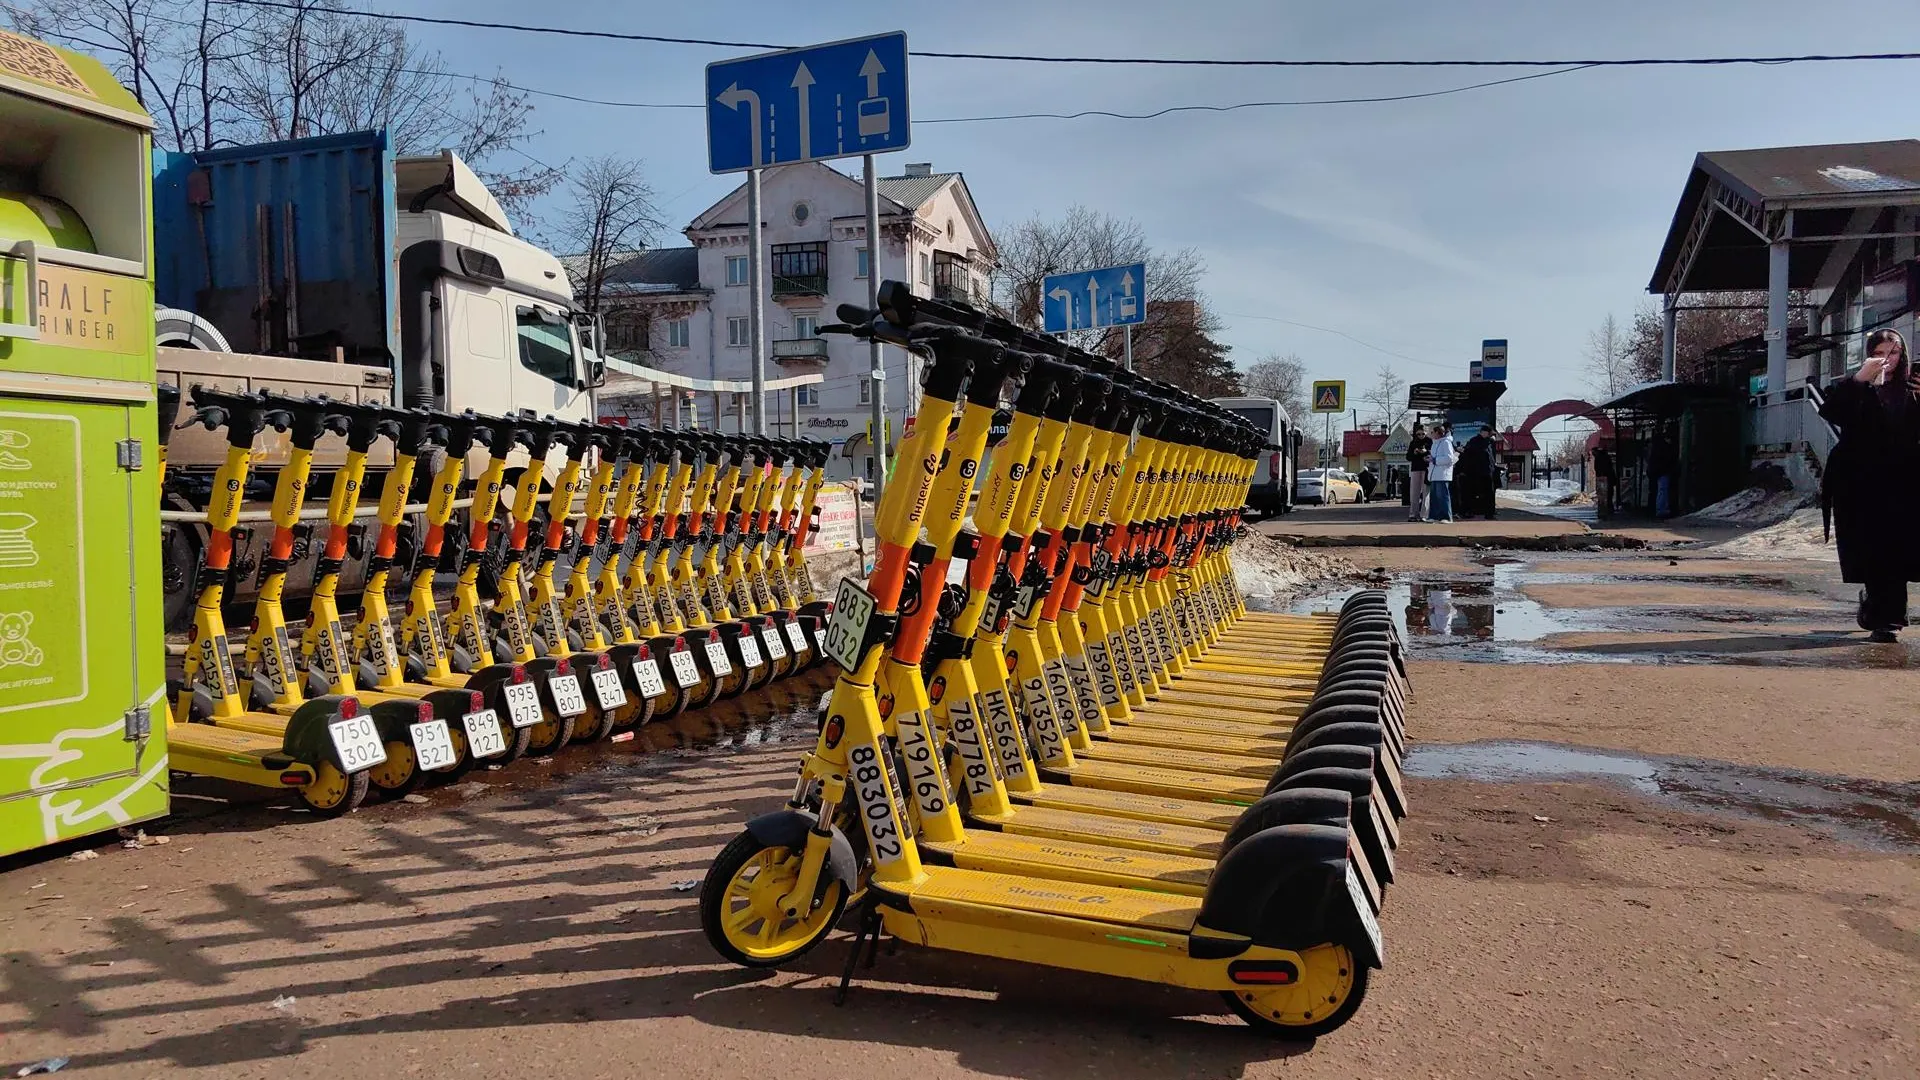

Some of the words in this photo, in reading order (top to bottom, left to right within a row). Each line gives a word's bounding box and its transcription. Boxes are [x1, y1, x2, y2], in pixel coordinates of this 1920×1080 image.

[39, 279, 112, 315] RALF
[40, 315, 114, 340] RINGER
[223, 493, 236, 518] Яндекс
[287, 491, 300, 515] Яндекс
[910, 475, 931, 522] Яндекс
[923, 454, 937, 475] Go
[950, 481, 970, 521] Яндекс
[1000, 483, 1018, 520] Яндекс
[1030, 481, 1047, 518] Яндекс
[1042, 465, 1053, 481] Go
[1062, 479, 1077, 513] Яндекс
[1072, 464, 1081, 479] Go
[1083, 484, 1098, 515] Яндекс
[1099, 478, 1116, 518] Яндекс
[707, 576, 724, 612] 299343
[735, 578, 750, 613] 146498
[754, 572, 769, 605] 202353
[774, 569, 787, 602] 628146
[796, 565, 810, 598] 784036
[634, 589, 651, 628] 747715
[659, 586, 675, 624] 426271
[681, 581, 698, 619] 736448
[839, 588, 869, 628] 883
[505, 607, 525, 654] 369450
[541, 602, 559, 647] 592746
[576, 598, 594, 641] 817347
[606, 598, 624, 639] 282188
[765, 630, 780, 643] 282
[788, 624, 800, 634] 747
[1150, 610, 1175, 662] 338661
[318, 629, 340, 685] 995675
[417, 618, 436, 668] 270347
[463, 614, 482, 664] 461551
[708, 645, 724, 658] 592
[741, 638, 755, 650] 817
[771, 644, 785, 657] 188
[830, 622, 857, 664] 032
[1126, 626, 1151, 685] 328734
[1140, 619, 1163, 673] 303074
[201, 640, 224, 700] 951527
[262, 637, 285, 695] 849127
[637, 662, 657, 677] 461
[672, 653, 690, 667] 369
[679, 668, 696, 683] 450
[714, 660, 729, 673] 746
[746, 652, 759, 665] 347
[1089, 642, 1120, 706] 759401
[1109, 635, 1136, 693] 533293
[509, 686, 534, 703] 995
[555, 678, 576, 693] 459
[596, 672, 617, 688] 270
[602, 689, 622, 705] 347
[642, 678, 662, 693] 551
[1046, 661, 1078, 734] 160491
[1071, 662, 1099, 721] 73460
[515, 705, 539, 722] 675
[560, 695, 580, 711] 807
[1025, 678, 1064, 759] 913524
[335, 719, 370, 743] 750
[415, 724, 446, 743] 951
[467, 714, 494, 732] 849
[985, 690, 1024, 777] HK563E
[344, 742, 379, 765] 302
[421, 745, 449, 765] 527
[474, 733, 499, 752] 127
[950, 701, 992, 795] 787784
[898, 712, 944, 813] 719169
[852, 747, 901, 859] 883032
[1040, 847, 1103, 860] Яндекс
[1008, 886, 1077, 901] Яндекс
